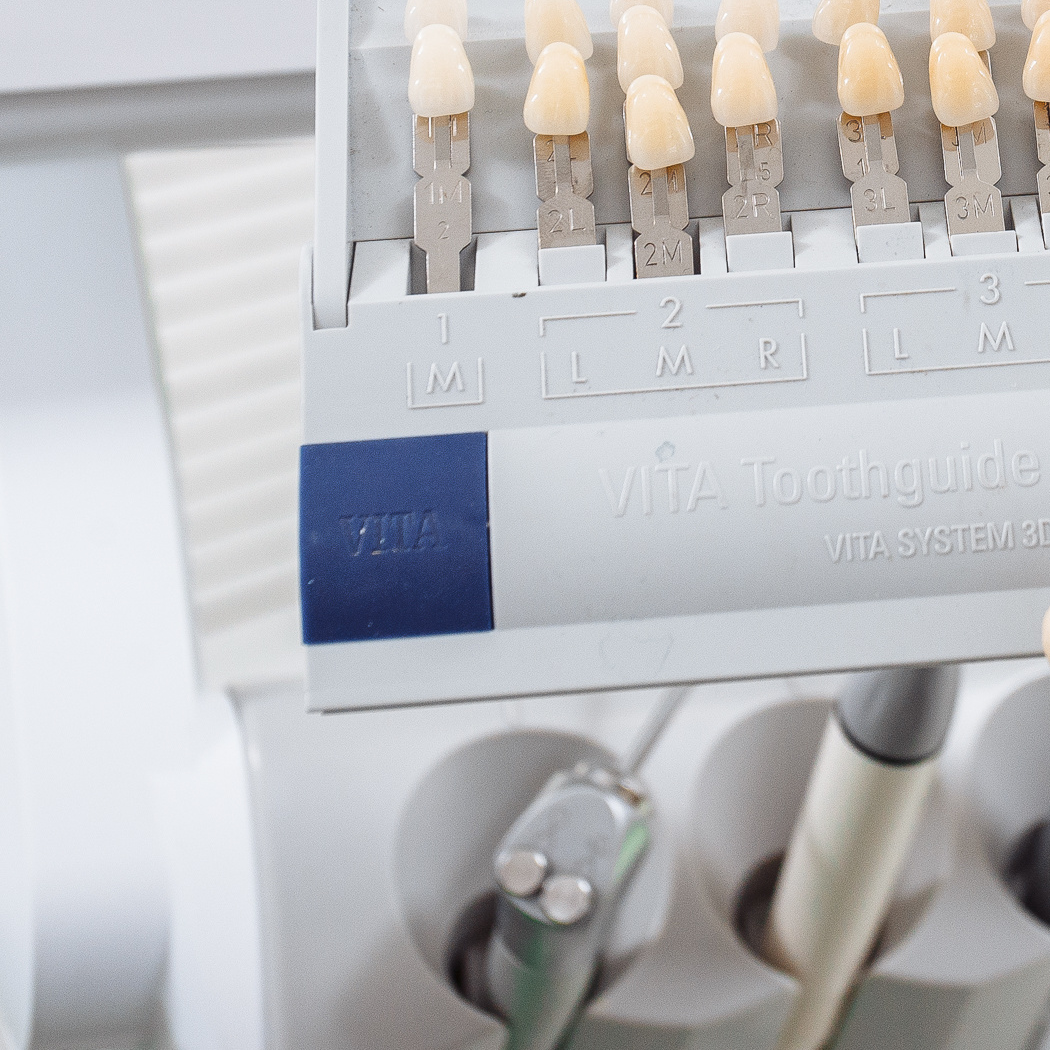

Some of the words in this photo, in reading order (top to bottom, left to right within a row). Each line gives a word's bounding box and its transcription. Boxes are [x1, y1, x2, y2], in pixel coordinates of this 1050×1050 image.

[733, 192, 777, 219] 2R
[863, 187, 897, 212] 3L
[955, 193, 995, 220] 3M
[547, 208, 587, 233] 2L
[643, 238, 684, 267] 2M
[978, 272, 1001, 305] 3
[436, 312, 449, 344] 1
[659, 296, 684, 329] 2
[893, 327, 910, 360] L
[977, 320, 1016, 353] M
[426, 360, 465, 394] M
[571, 350, 589, 384] L
[656, 344, 695, 377] M
[758, 337, 780, 369] R
[597, 461, 729, 519] VITA
[740, 438, 1042, 509] Toothguide
[824, 528, 894, 565] VITA
[897, 520, 1015, 559] SYSTEM
